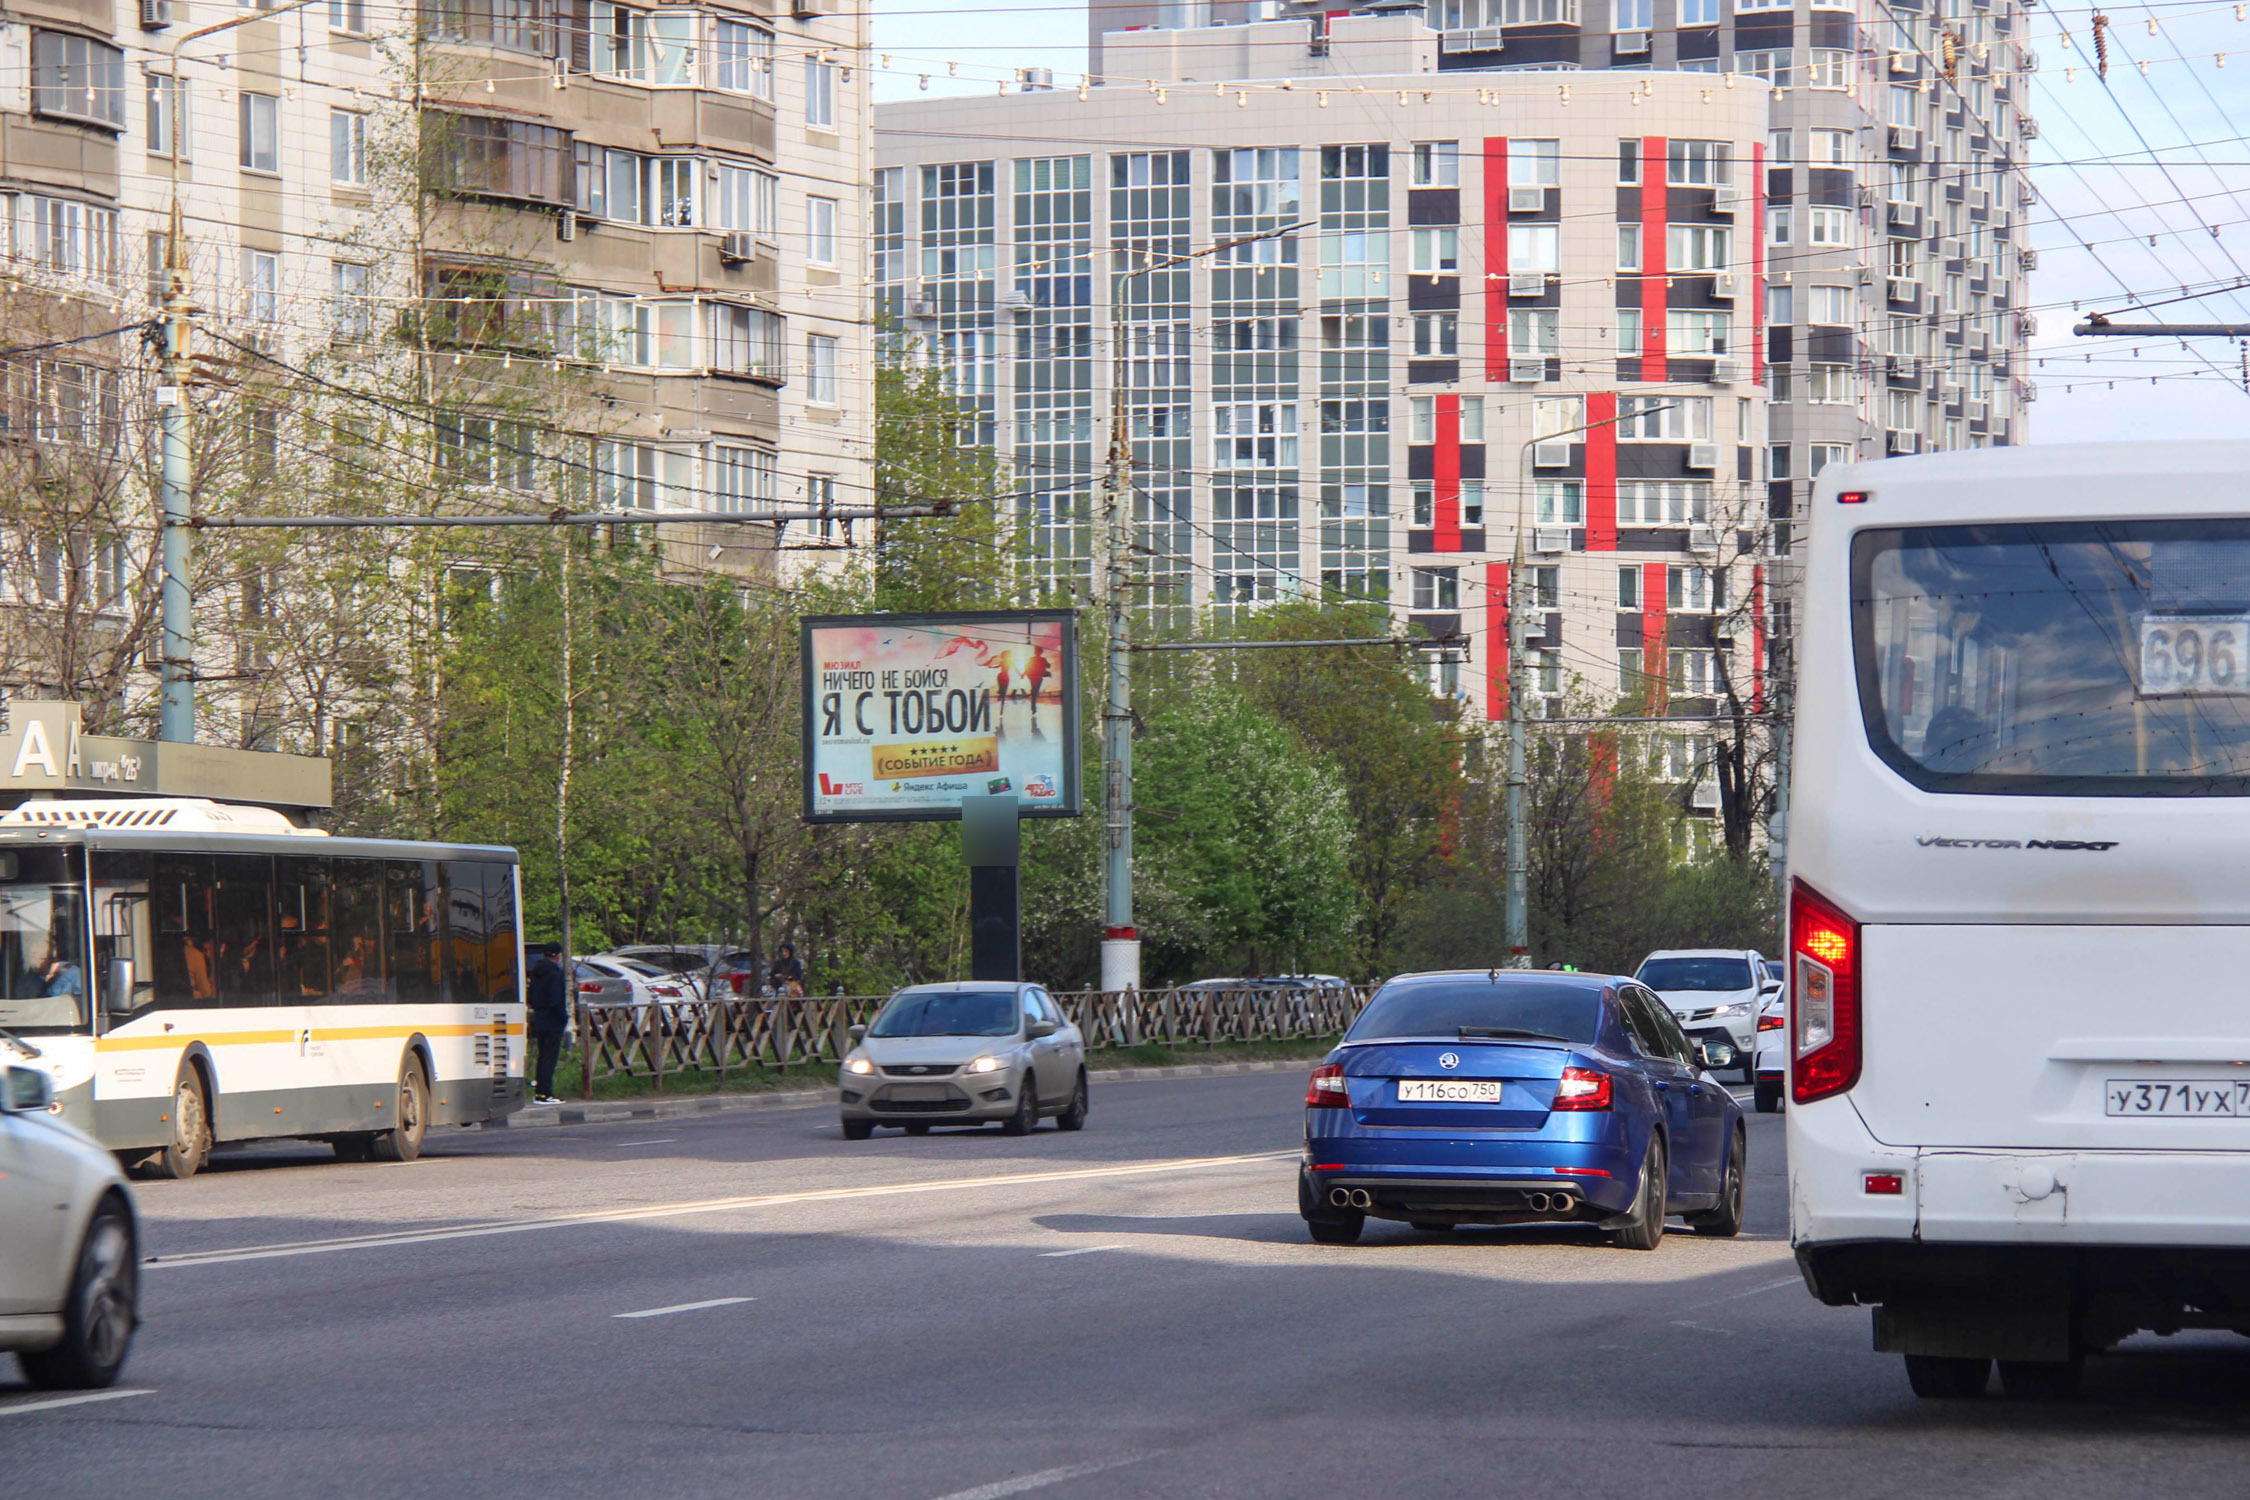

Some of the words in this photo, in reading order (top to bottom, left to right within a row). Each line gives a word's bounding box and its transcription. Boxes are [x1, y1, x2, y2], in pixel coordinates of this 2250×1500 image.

[823, 660, 861, 670] МЮЗИКЛ
[2144, 629, 2236, 687] 696
[823, 671, 875, 690] НИЧЕГО
[881, 670, 899, 689] НЕ
[904, 665, 948, 689] БОЙСЯ
[822, 692, 841, 736] Я
[855, 691, 874, 735] С
[884, 684, 991, 735] ТОБОЙ
[885, 756, 945, 771] СОБЫТИЕ
[949, 753, 985, 767] ГОДА
[903, 783, 934, 792] Яндекс
[936, 782, 968, 791] Афиша
[1914, 836, 2021, 849] VECTOR
[2026, 839, 2120, 851] NEXT
[1404, 1083, 1468, 1099] У116СО
[1472, 1083, 1496, 1096] 750
[2116, 1085, 2231, 1112] У371УХ
